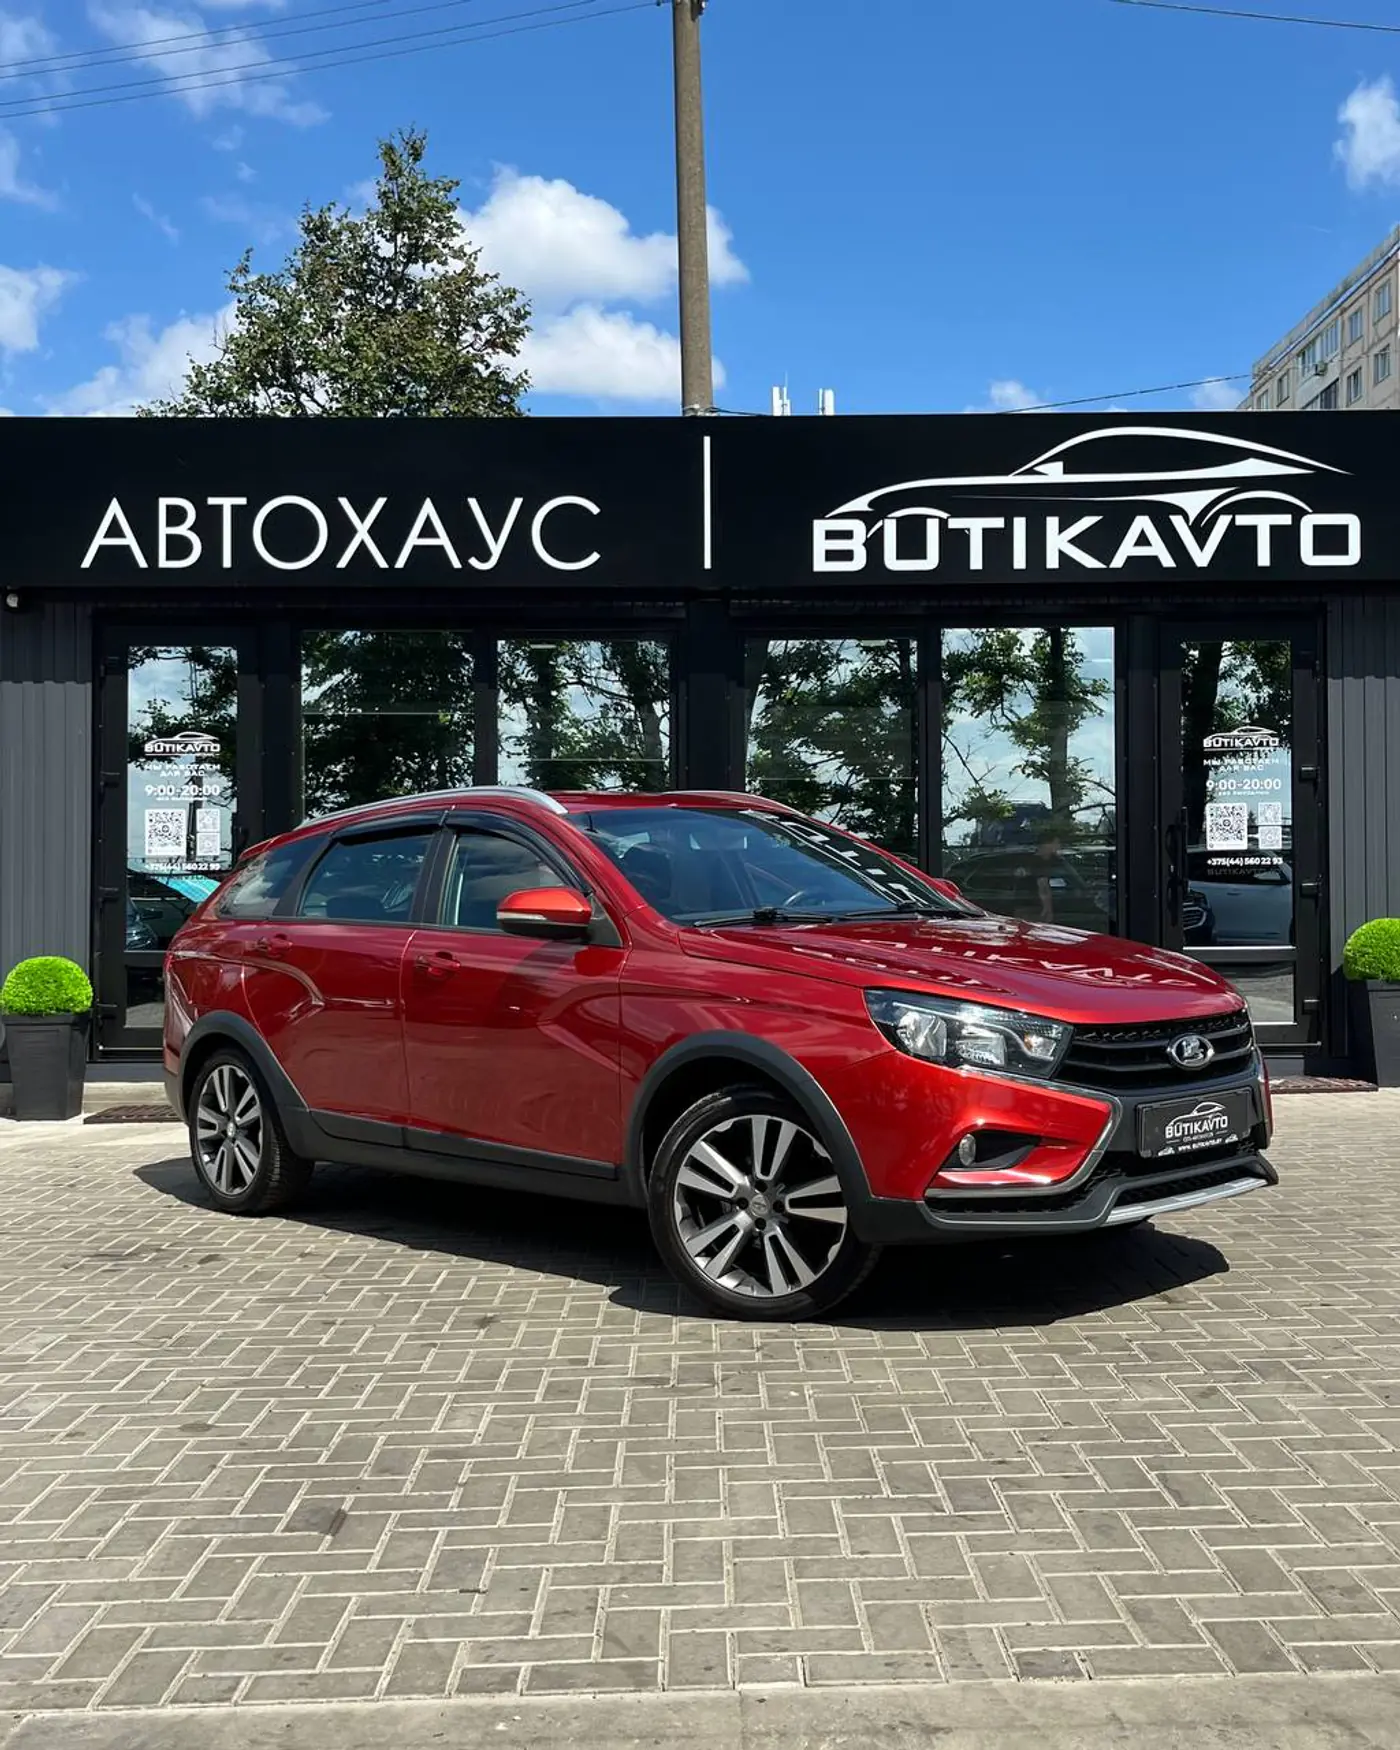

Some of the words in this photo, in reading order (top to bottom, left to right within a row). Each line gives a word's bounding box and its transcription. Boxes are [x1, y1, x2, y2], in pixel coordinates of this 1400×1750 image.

[81, 494, 601, 570] АВТОХАУС
[812, 513, 1361, 572] BUTIKAVTO
[144, 743, 220, 753] BUTIKAVTO
[1203, 737, 1279, 748] BUTIKAVTO
[145, 784, 221, 796] 9:00-20:00
[1205, 778, 1282, 791] 9:00-20:00
[1165, 1115, 1228, 1139] BUTIKAVTO
